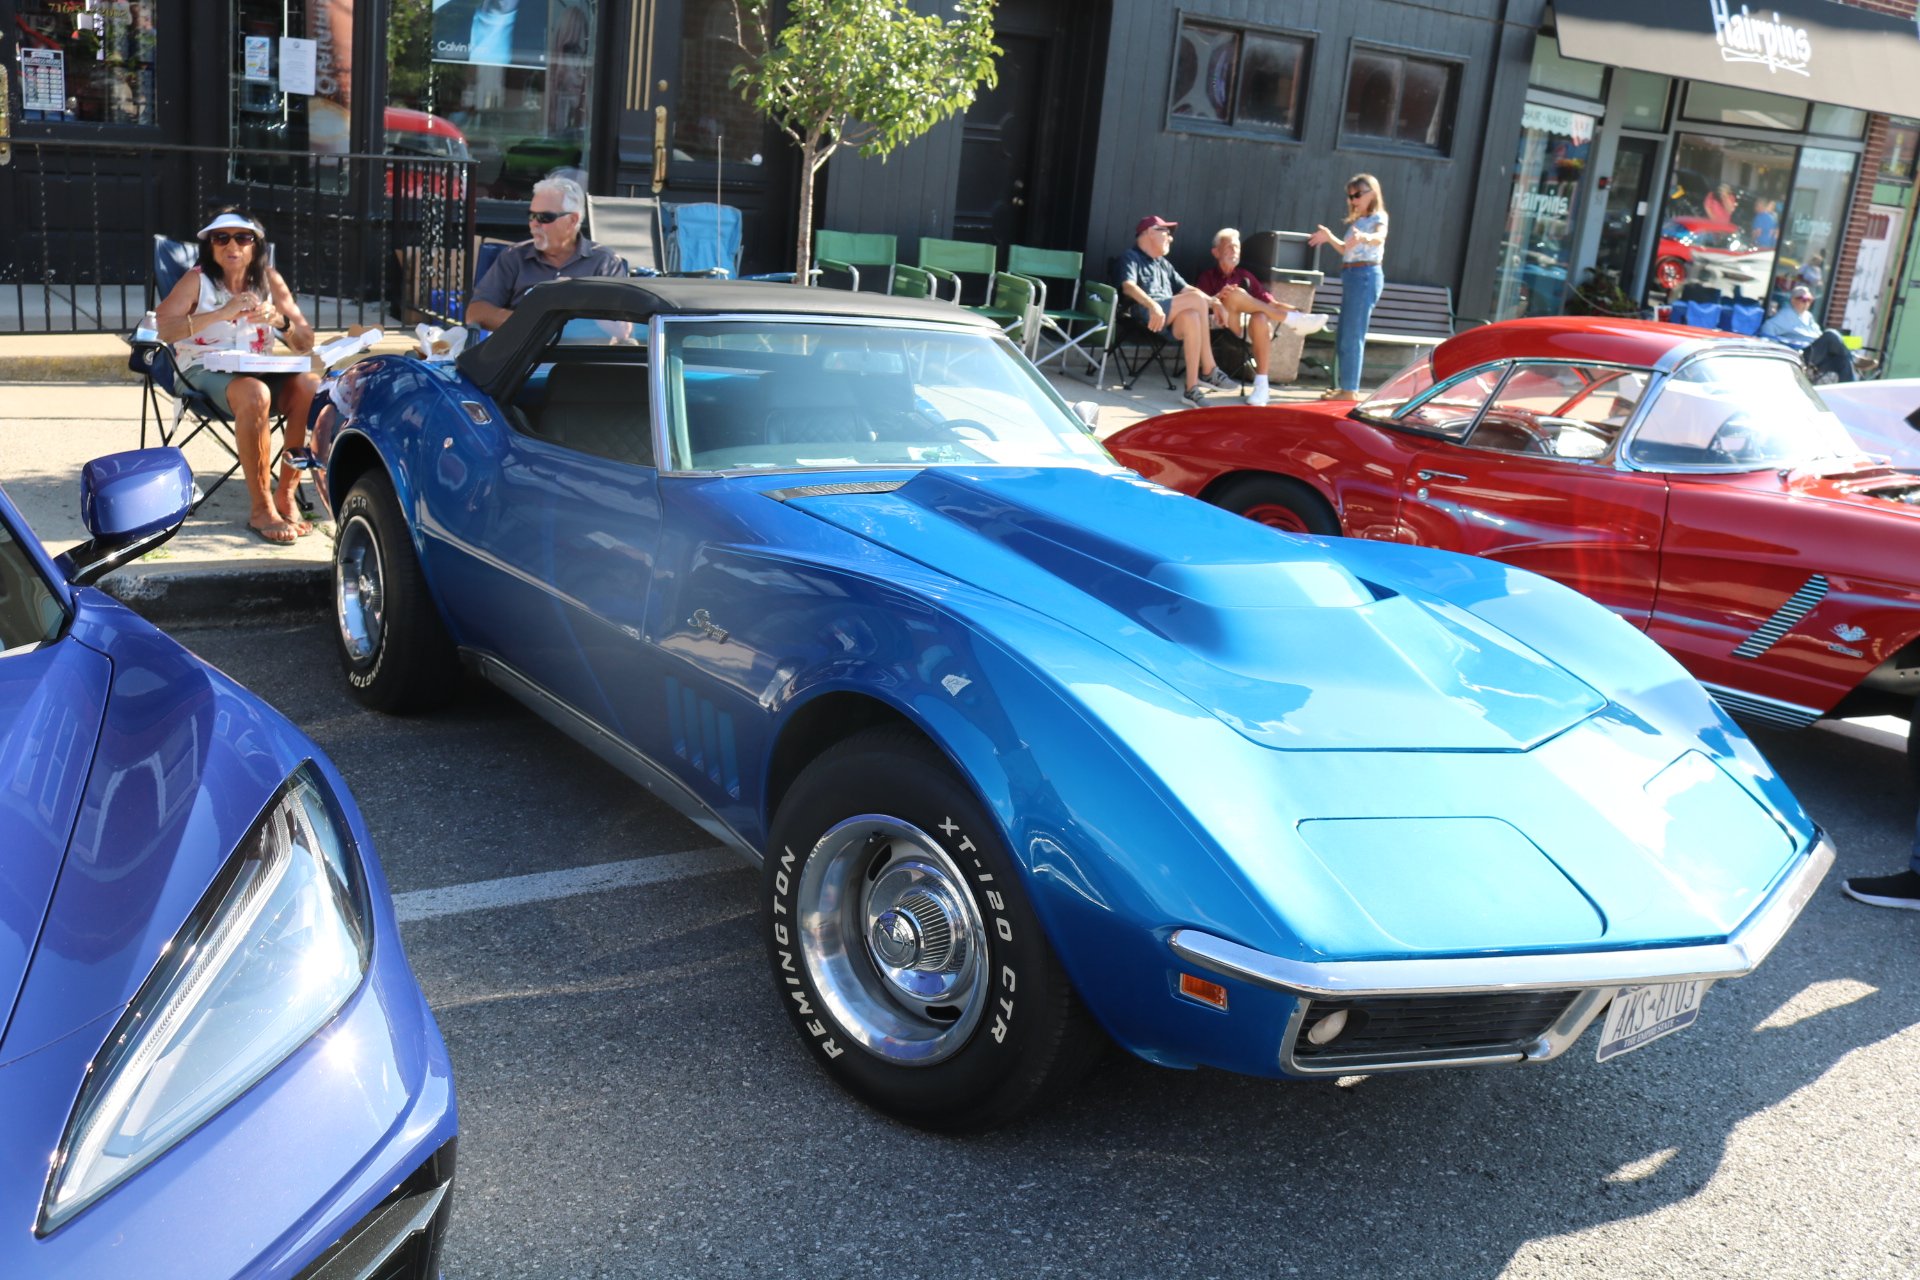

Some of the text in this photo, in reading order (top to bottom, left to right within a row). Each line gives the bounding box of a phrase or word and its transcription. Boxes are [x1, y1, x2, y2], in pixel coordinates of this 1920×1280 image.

[437, 40, 467, 52] Calvin
[1710, 0, 1811, 73] Hairpins
[1547, 113, 1569, 128] NAILS
[1511, 182, 1568, 221] Hairpins
[352, 496, 367, 510] CTR
[937, 816, 1016, 1044] XT-120 CTR
[773, 844, 844, 1059] REMINGTON
